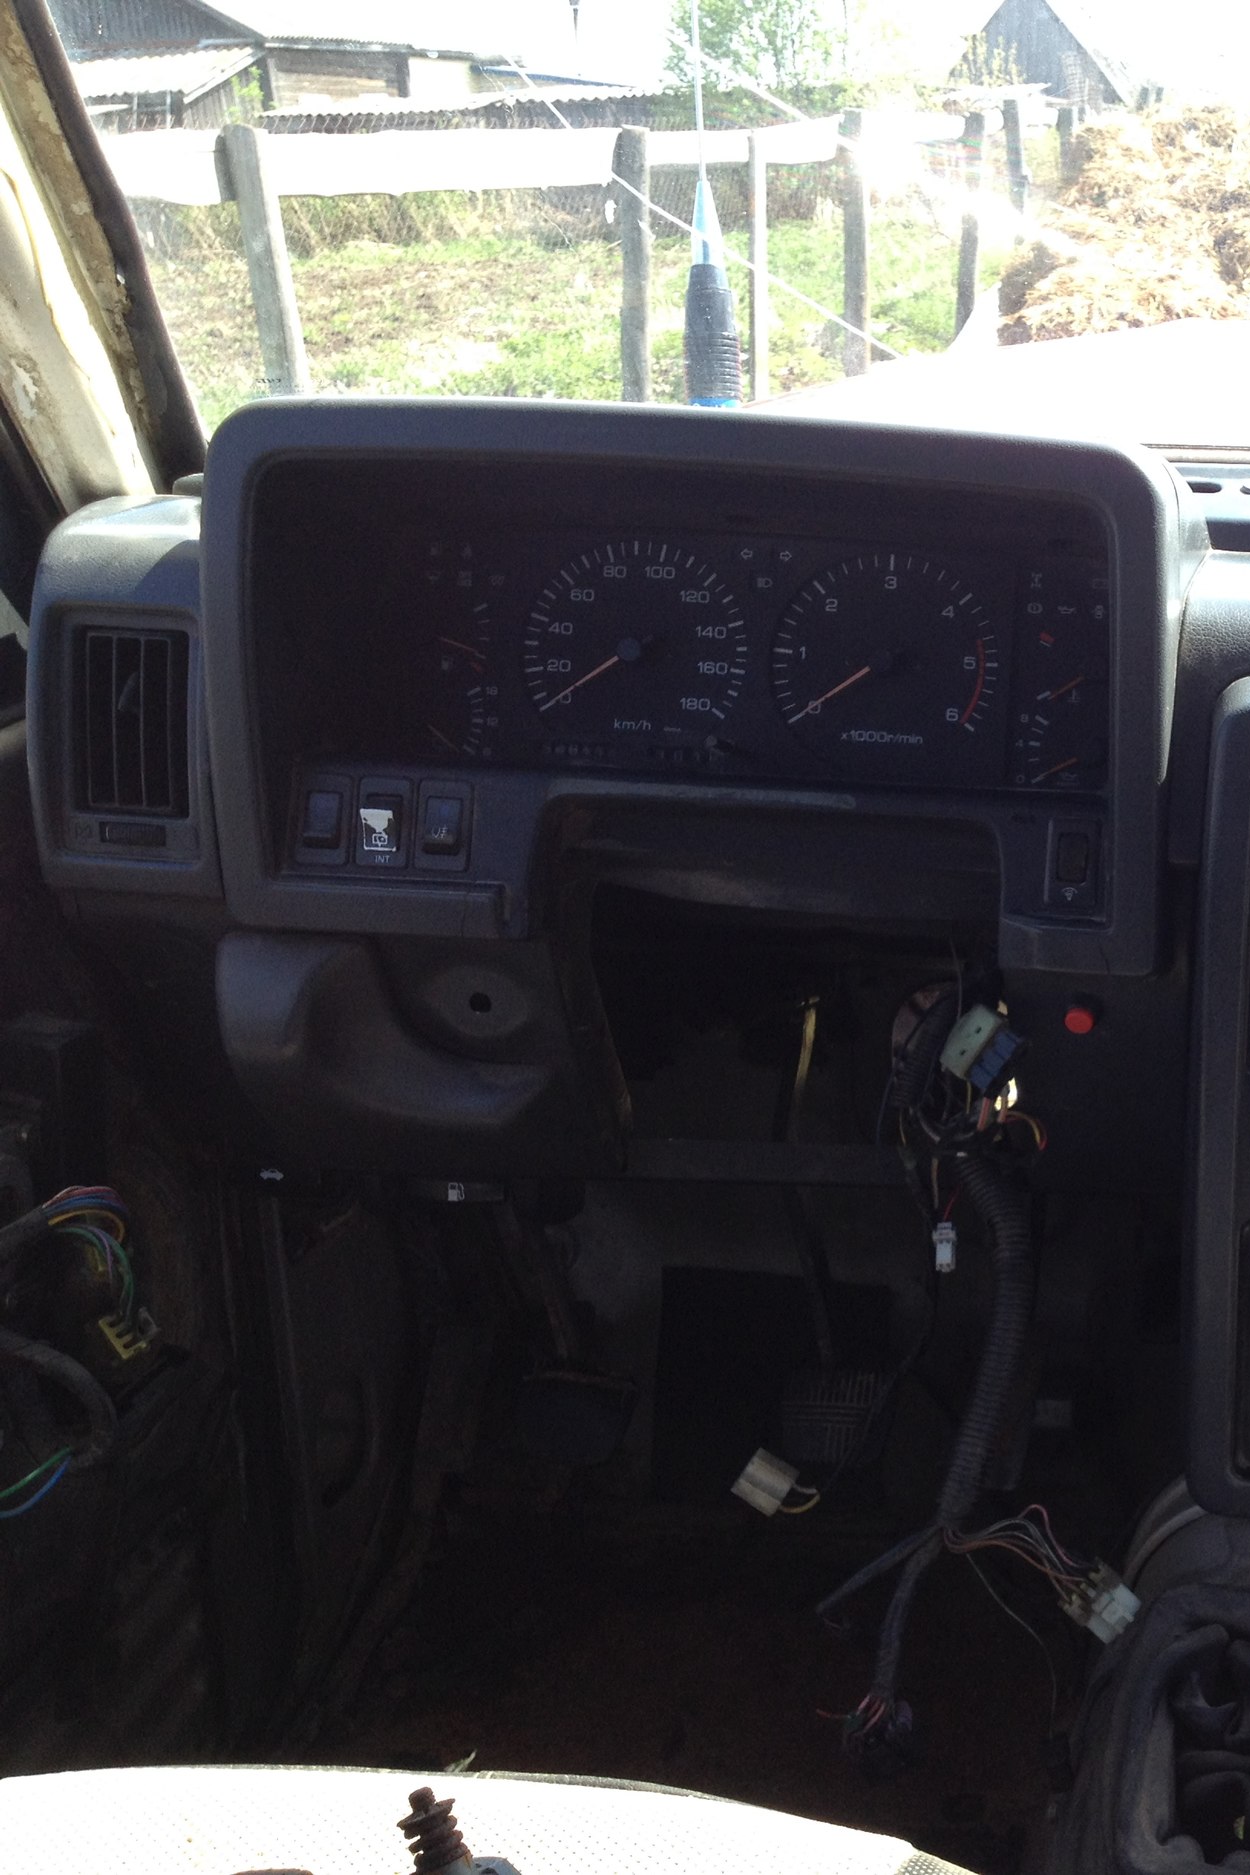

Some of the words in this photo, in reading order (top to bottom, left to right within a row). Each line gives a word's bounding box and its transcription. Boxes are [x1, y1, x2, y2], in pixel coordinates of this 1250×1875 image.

[602, 565, 628, 579] 80
[643, 565, 676, 580] 100
[883, 575, 898, 590] 3
[569, 588, 596, 602] 60
[679, 590, 711, 604] 120
[824, 598, 839, 613] 2
[940, 605, 956, 619] 4
[547, 621, 574, 635] 40
[694, 625, 728, 640] 140
[798, 646, 807, 660] 1
[546, 659, 572, 673] 20
[696, 661, 729, 676] 160
[962, 656, 977, 671] 5
[679, 697, 712, 712] 180
[945, 707, 960, 722] 6
[613, 717, 652, 732] km/h
[840, 729, 924, 745] x1000r/min
[374, 855, 391, 864] INT
